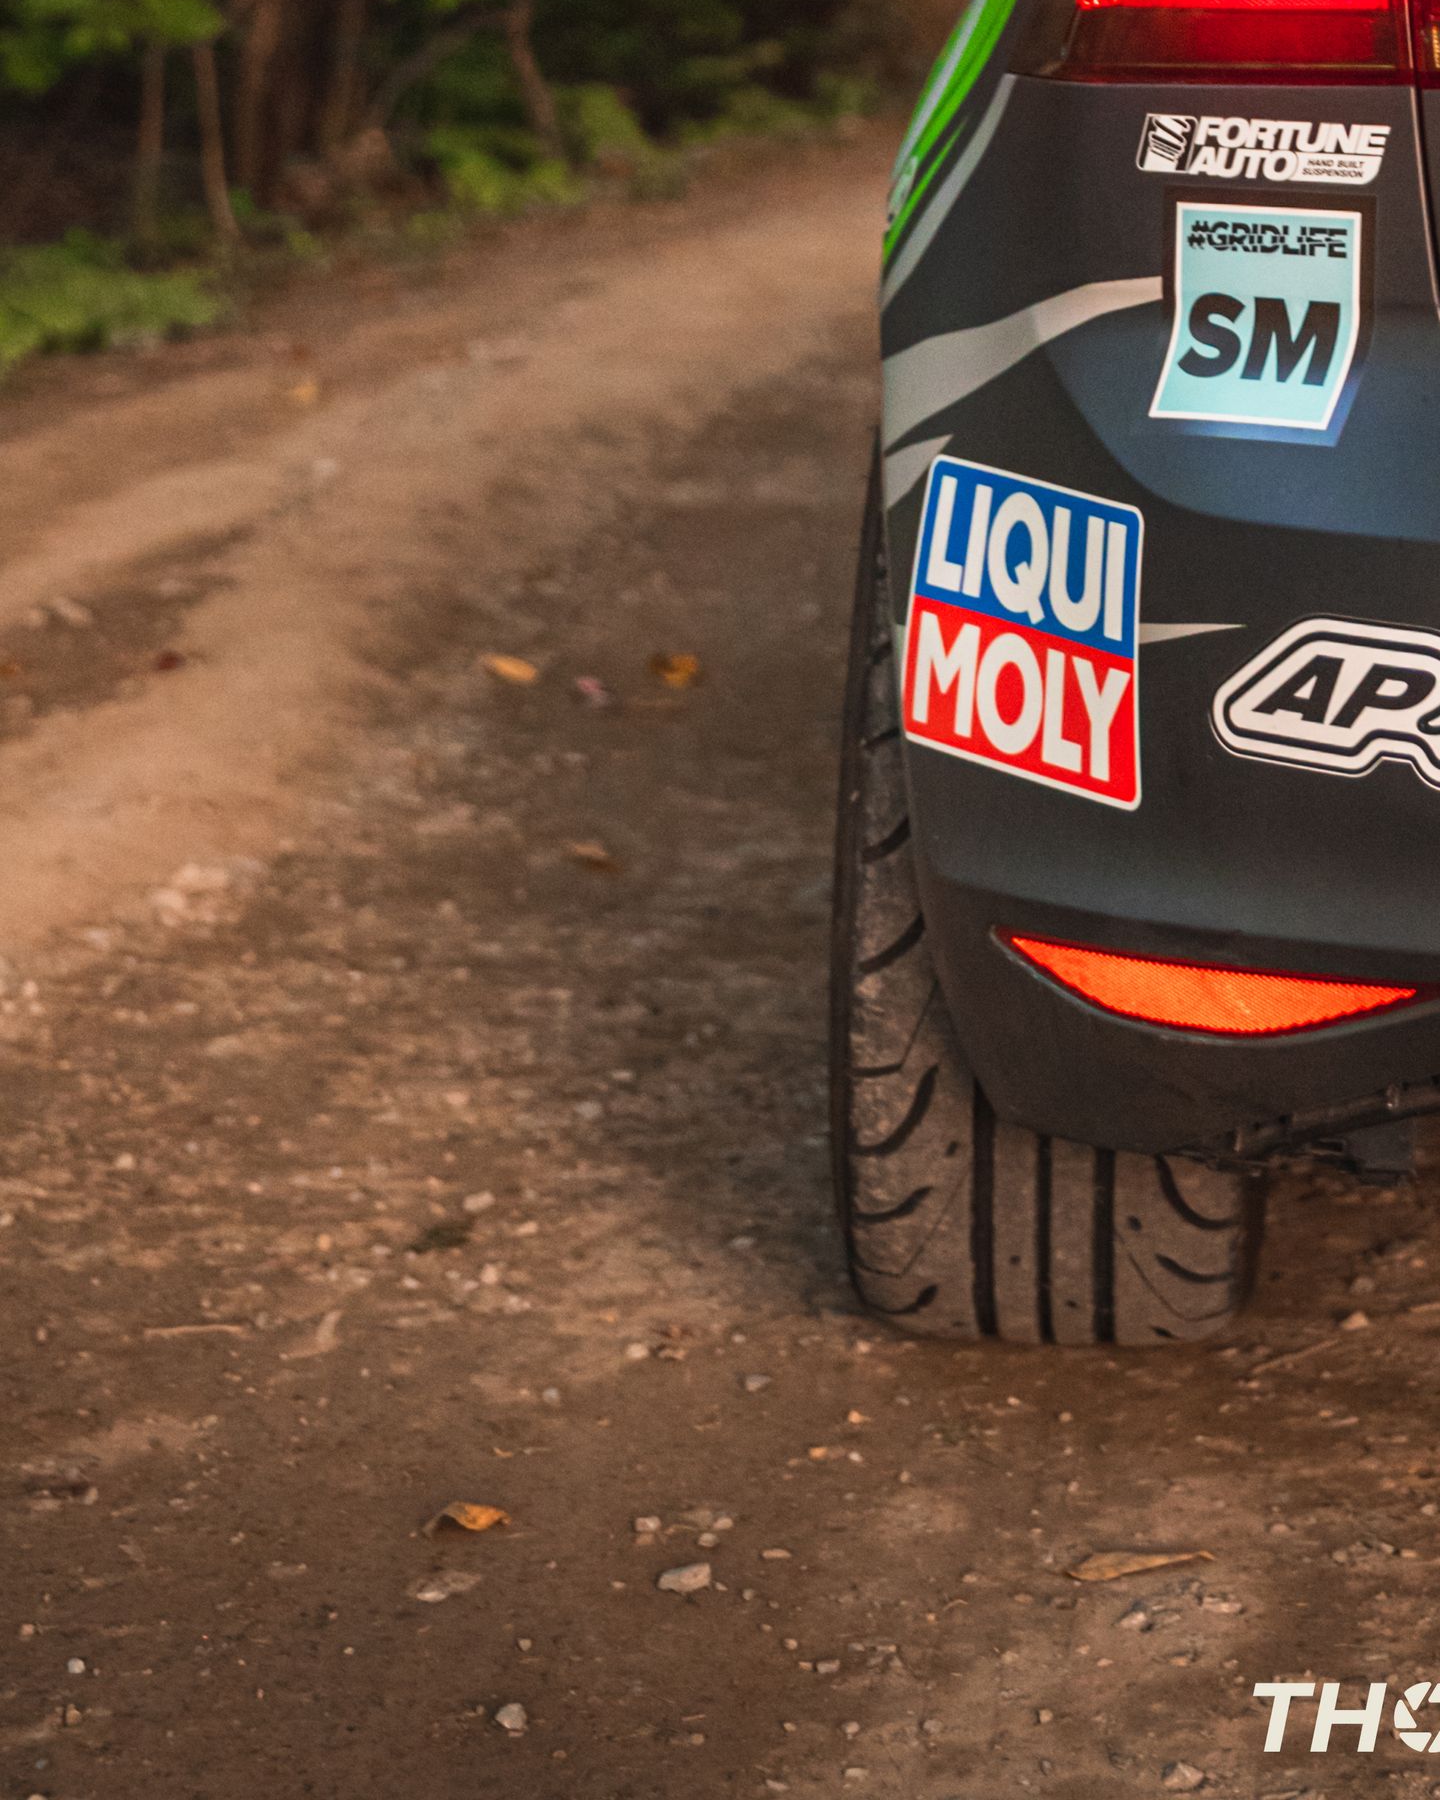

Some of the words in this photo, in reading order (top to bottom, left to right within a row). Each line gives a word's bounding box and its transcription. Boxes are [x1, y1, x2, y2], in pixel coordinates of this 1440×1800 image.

[1194, 115, 1392, 156] FORTUNE
[1188, 145, 1298, 182] AUTO
[1302, 167, 1363, 178] SUSPENSION
[1187, 220, 1348, 259] #GRIDLIFE
[1177, 292, 1341, 387] SM
[925, 474, 1128, 643] LIQUI
[912, 610, 1132, 783] MOLY
